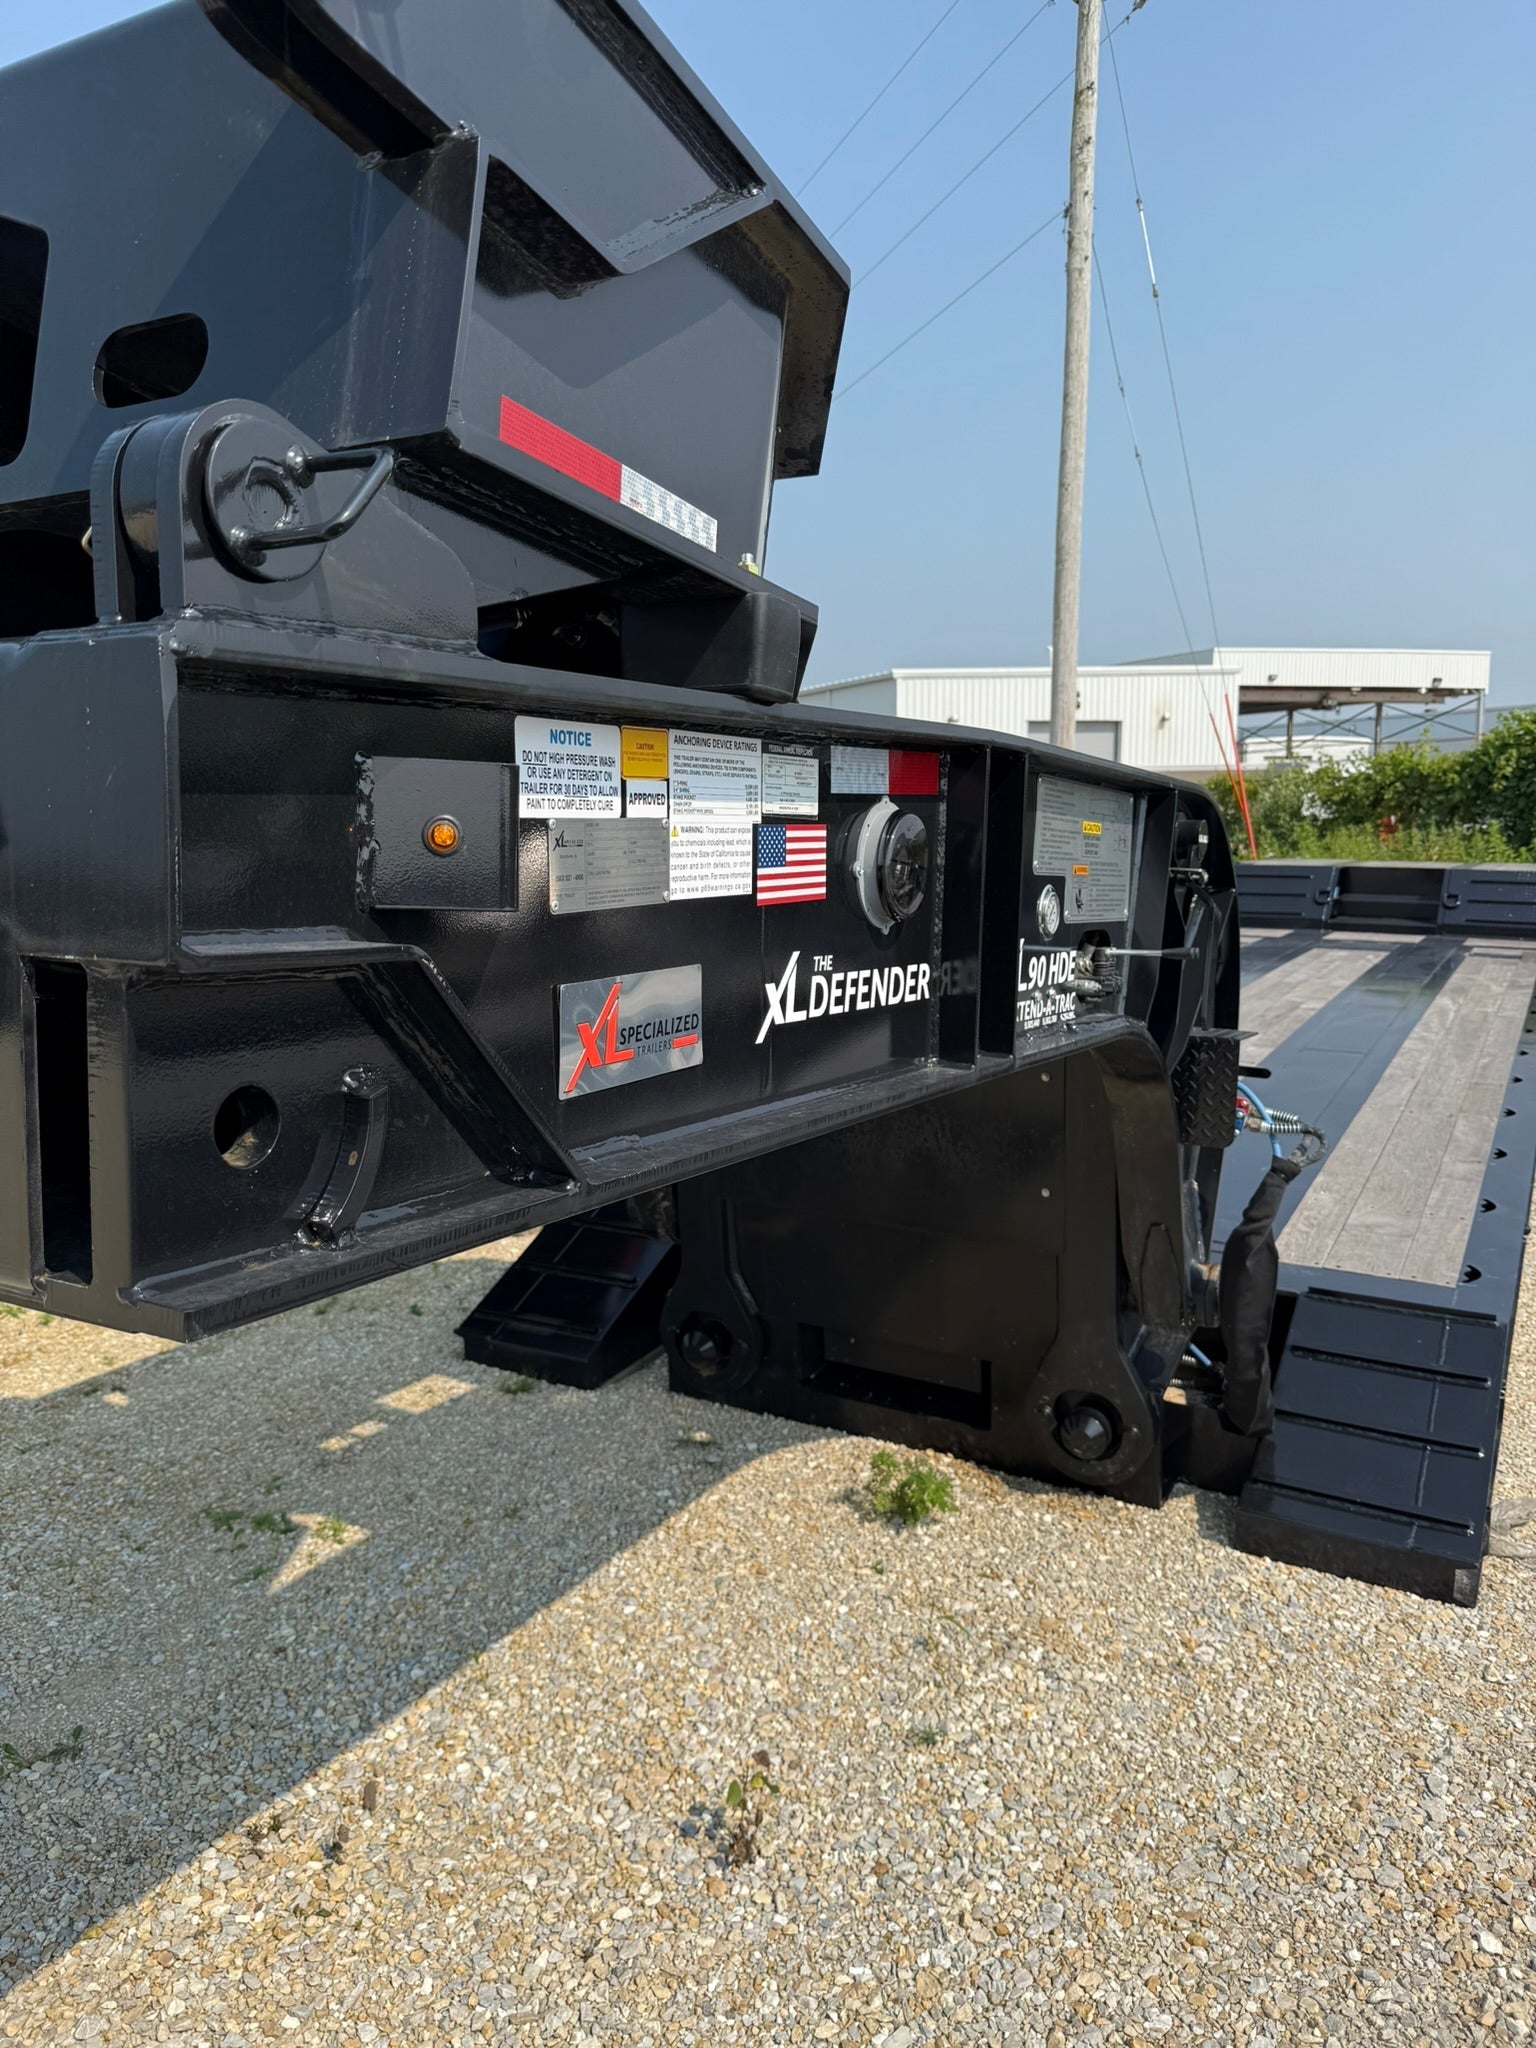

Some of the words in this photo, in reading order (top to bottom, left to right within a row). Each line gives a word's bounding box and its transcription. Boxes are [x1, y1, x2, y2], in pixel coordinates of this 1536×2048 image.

[550, 729, 592, 747] NOTICE
[674, 735, 711, 748] ANCHORING
[713, 739, 732, 750] DEVICE
[734, 741, 758, 752] RATINGS
[522, 751, 532, 762] DO
[534, 752, 547, 763] NOT
[549, 753, 565, 764] HIGH
[566, 754, 598, 766] PRESSURE
[599, 756, 616, 767] WASH
[527, 767, 537, 778] OR
[539, 768, 551, 779] USE
[553, 768, 566, 780] ANY
[567, 769, 603, 781] DETERGENT
[604, 771, 612, 782] ON
[521, 782, 548, 794] TRAILER
[549, 784, 563, 795] FOR
[564, 784, 571, 795] 30
[572, 785, 589, 796] DAYS
[590, 785, 597, 796] TO
[598, 786, 618, 797] ALLOW
[527, 798, 546, 810] PAINT
[547, 799, 556, 810] TO
[557, 799, 597, 811] COMPLETELY
[598, 800, 614, 811] CURE
[629, 793, 666, 806] APPROVED
[680, 826, 704, 834] WARNING:
[715, 827, 729, 835] product
[553, 830, 568, 851] XL
[699, 850, 710, 858] State
[813, 955, 833, 972] THE
[1028, 955, 1047, 990] 90
[1048, 950, 1077, 985] HDE
[754, 951, 808, 1045] XL
[808, 963, 931, 1018] DEFENDER
[563, 982, 635, 1093] XL
[620, 1013, 699, 1045] SPECIALIZED
[637, 1039, 672, 1056] TRAILERS
